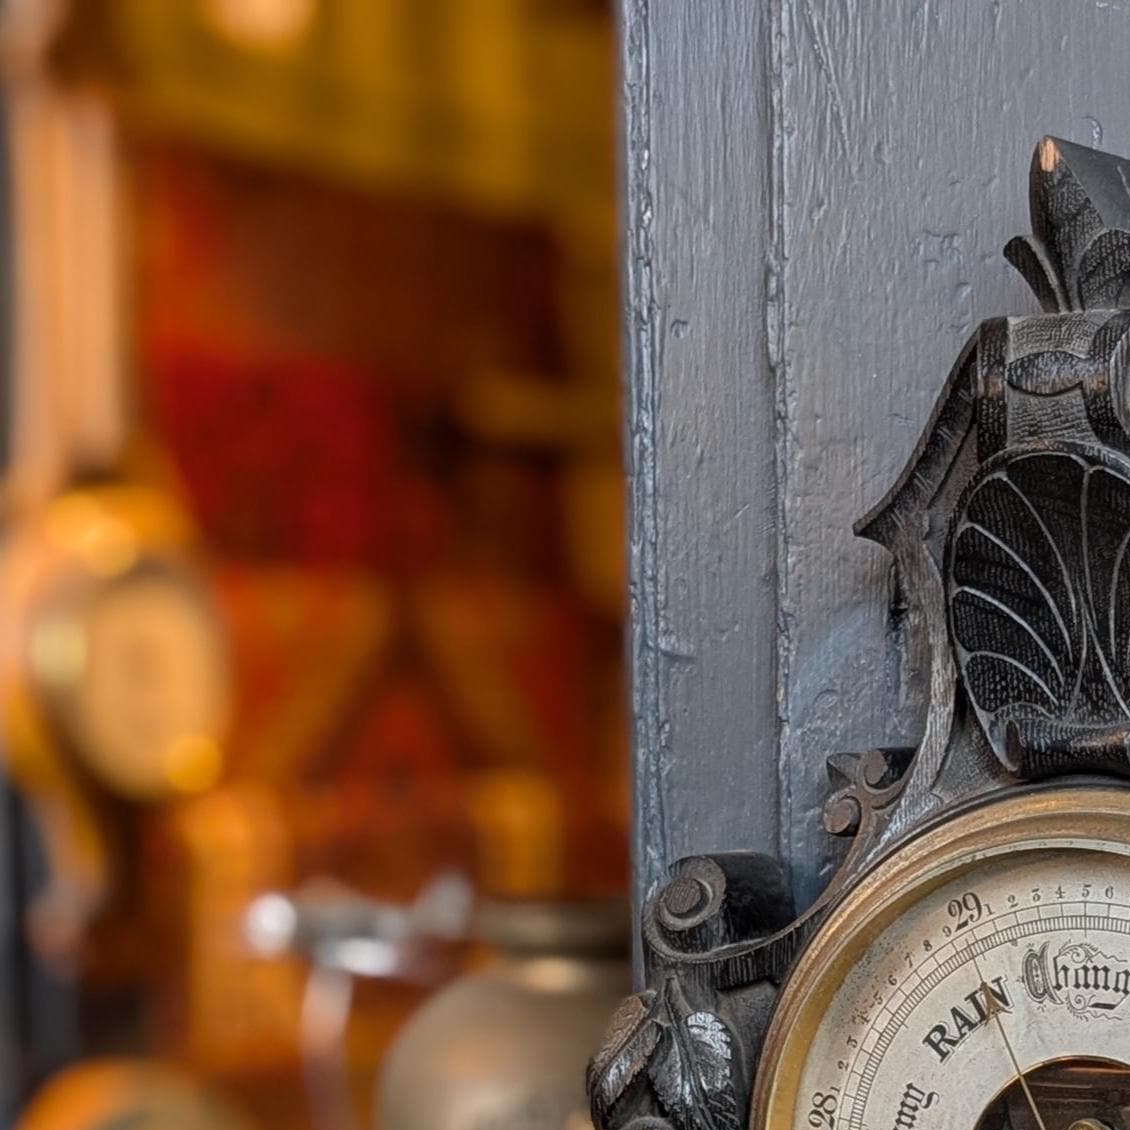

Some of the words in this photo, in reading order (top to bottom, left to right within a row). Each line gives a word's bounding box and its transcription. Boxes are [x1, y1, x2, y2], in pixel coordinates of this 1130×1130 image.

[808, 1092, 838, 1130] 28
[837, 1060, 849, 1072] 2
[888, 974, 897, 986] 6
[923, 940, 933, 952] 8
[942, 926, 952, 937] 9
[948, 892, 982, 932] 29
[984, 903, 995, 916] 1
[1007, 894, 1019, 908] 2
[1031, 887, 1041, 902] 3
[1055, 885, 1066, 899] 4
[1081, 884, 1092, 898] 5
[1104, 886, 1114, 899] 6
[921, 975, 1015, 1064] RAIN
